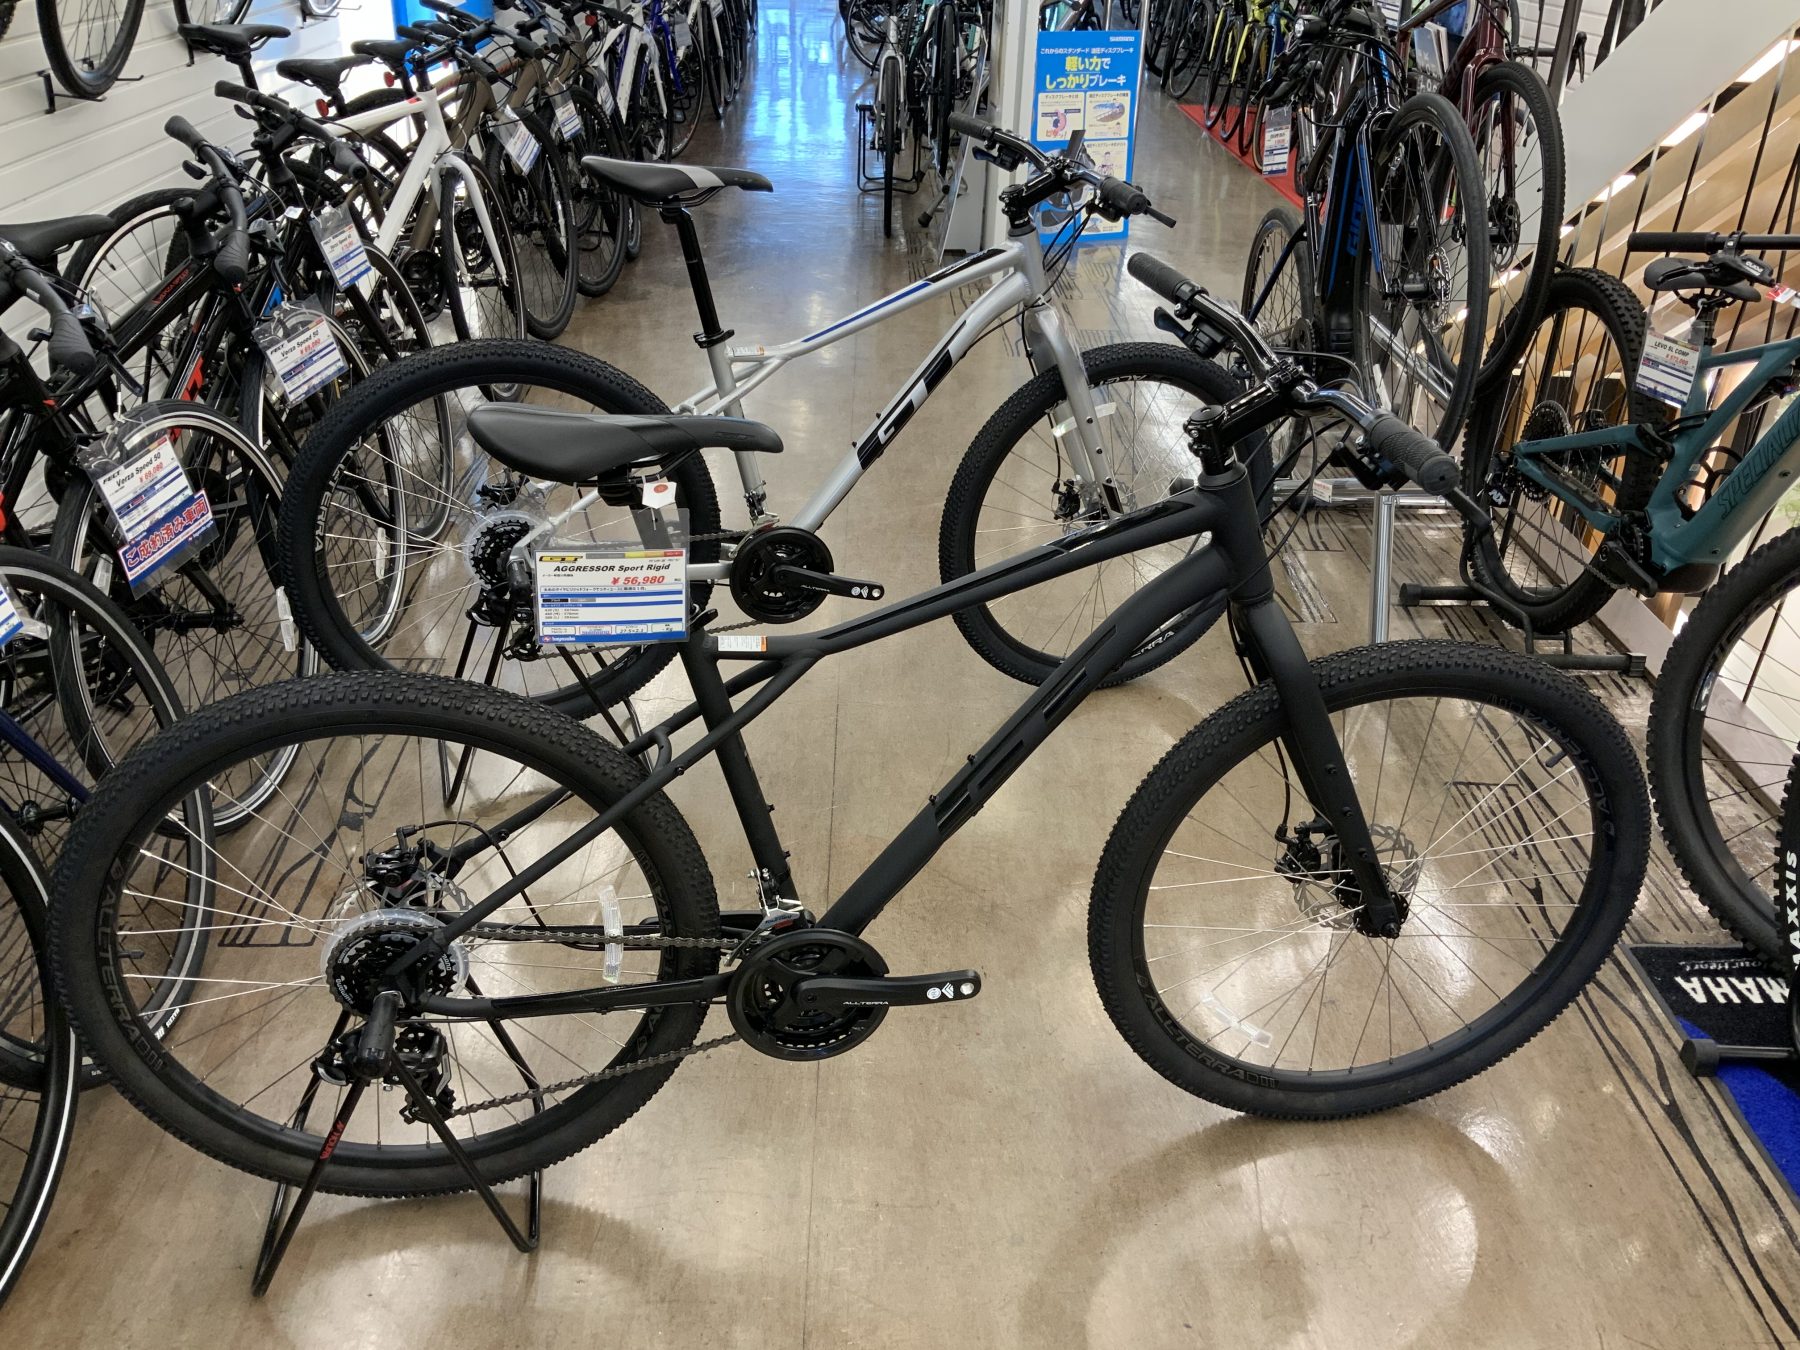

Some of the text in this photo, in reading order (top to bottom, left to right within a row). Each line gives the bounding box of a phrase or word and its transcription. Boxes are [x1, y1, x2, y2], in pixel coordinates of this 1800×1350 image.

[1065, 56, 1111, 71] 軽い力で
[1045, 74, 1126, 90] しっかりブレーキ
[1655, 341, 1690, 358] LEVO SL COMP
[115, 451, 161, 487] Verza Speed 50
[125, 498, 208, 567] ご成約済み車両
[553, 565, 616, 573] AGGRESSOR
[646, 563, 671, 571] Rigid
[610, 575, 665, 586] ¥ 56,980
